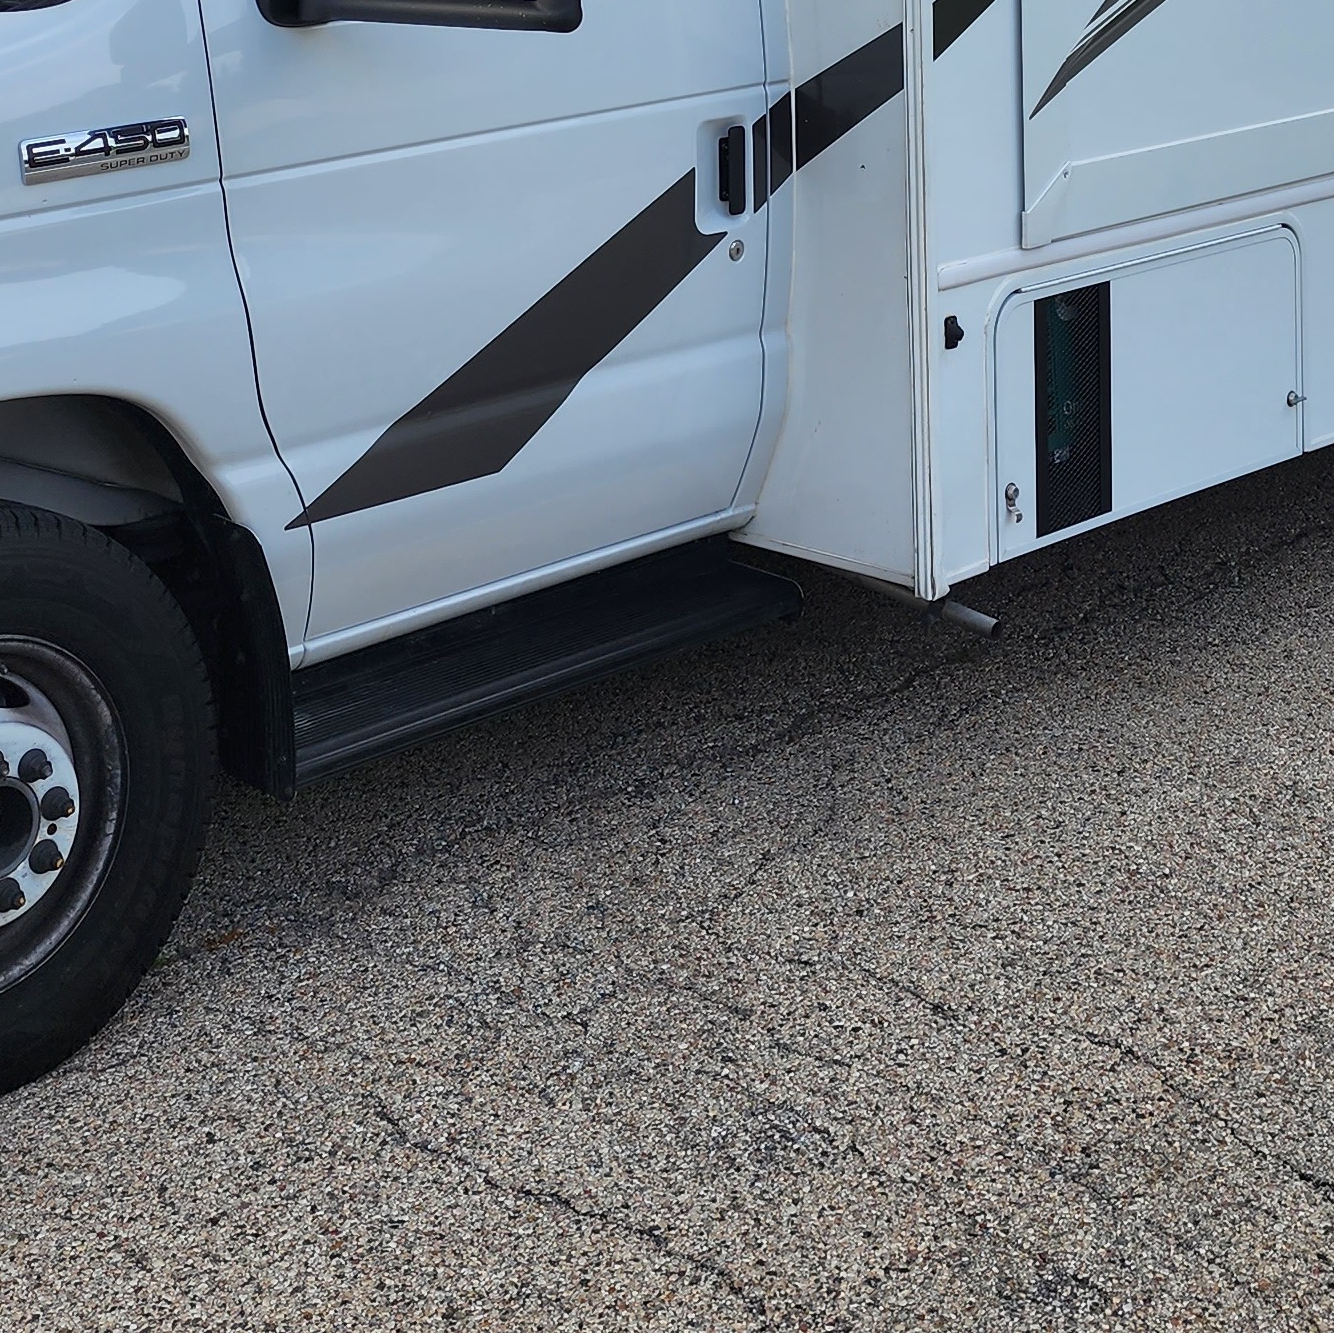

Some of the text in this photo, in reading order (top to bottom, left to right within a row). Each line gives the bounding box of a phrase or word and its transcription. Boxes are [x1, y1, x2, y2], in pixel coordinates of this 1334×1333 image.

[25, 118, 187, 169] E-450
[99, 149, 186, 171] SUPER DUTY
